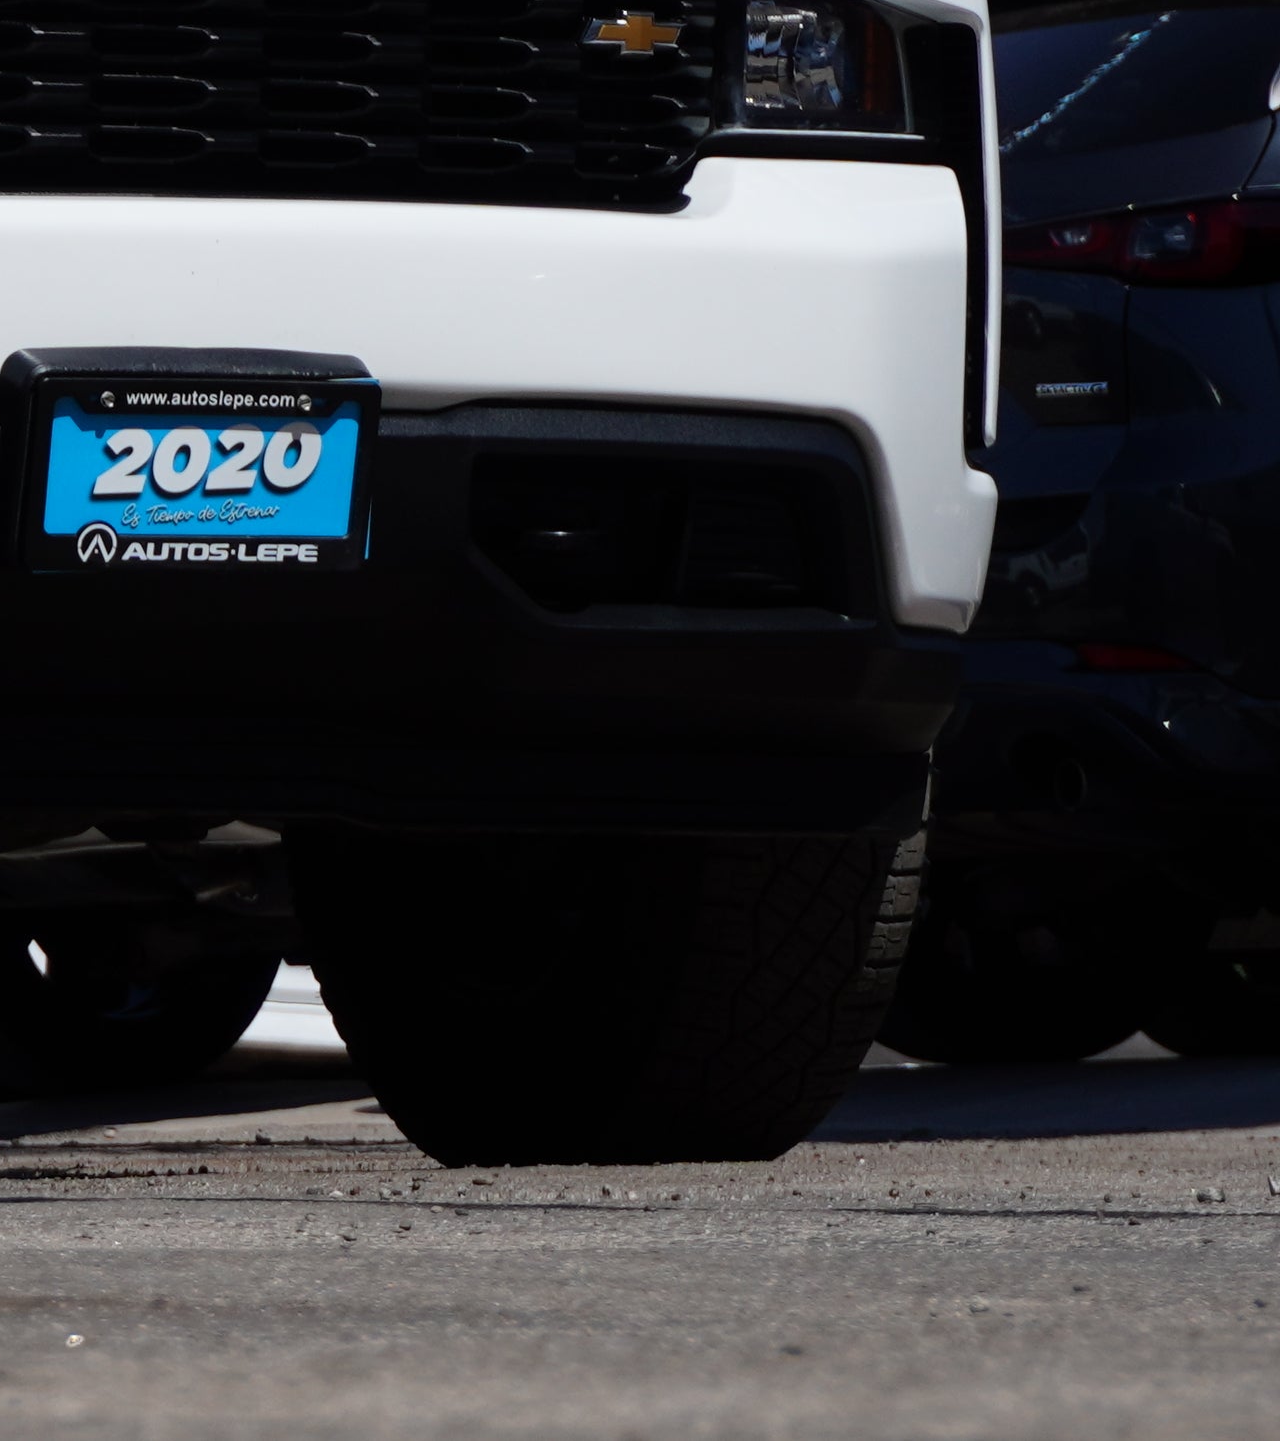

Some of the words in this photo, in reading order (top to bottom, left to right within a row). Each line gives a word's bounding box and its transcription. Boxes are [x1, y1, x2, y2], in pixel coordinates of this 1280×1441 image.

[126, 389, 295, 410] www.autoslepe.com
[91, 421, 323, 497] 2020
[198, 502, 216, 522] de
